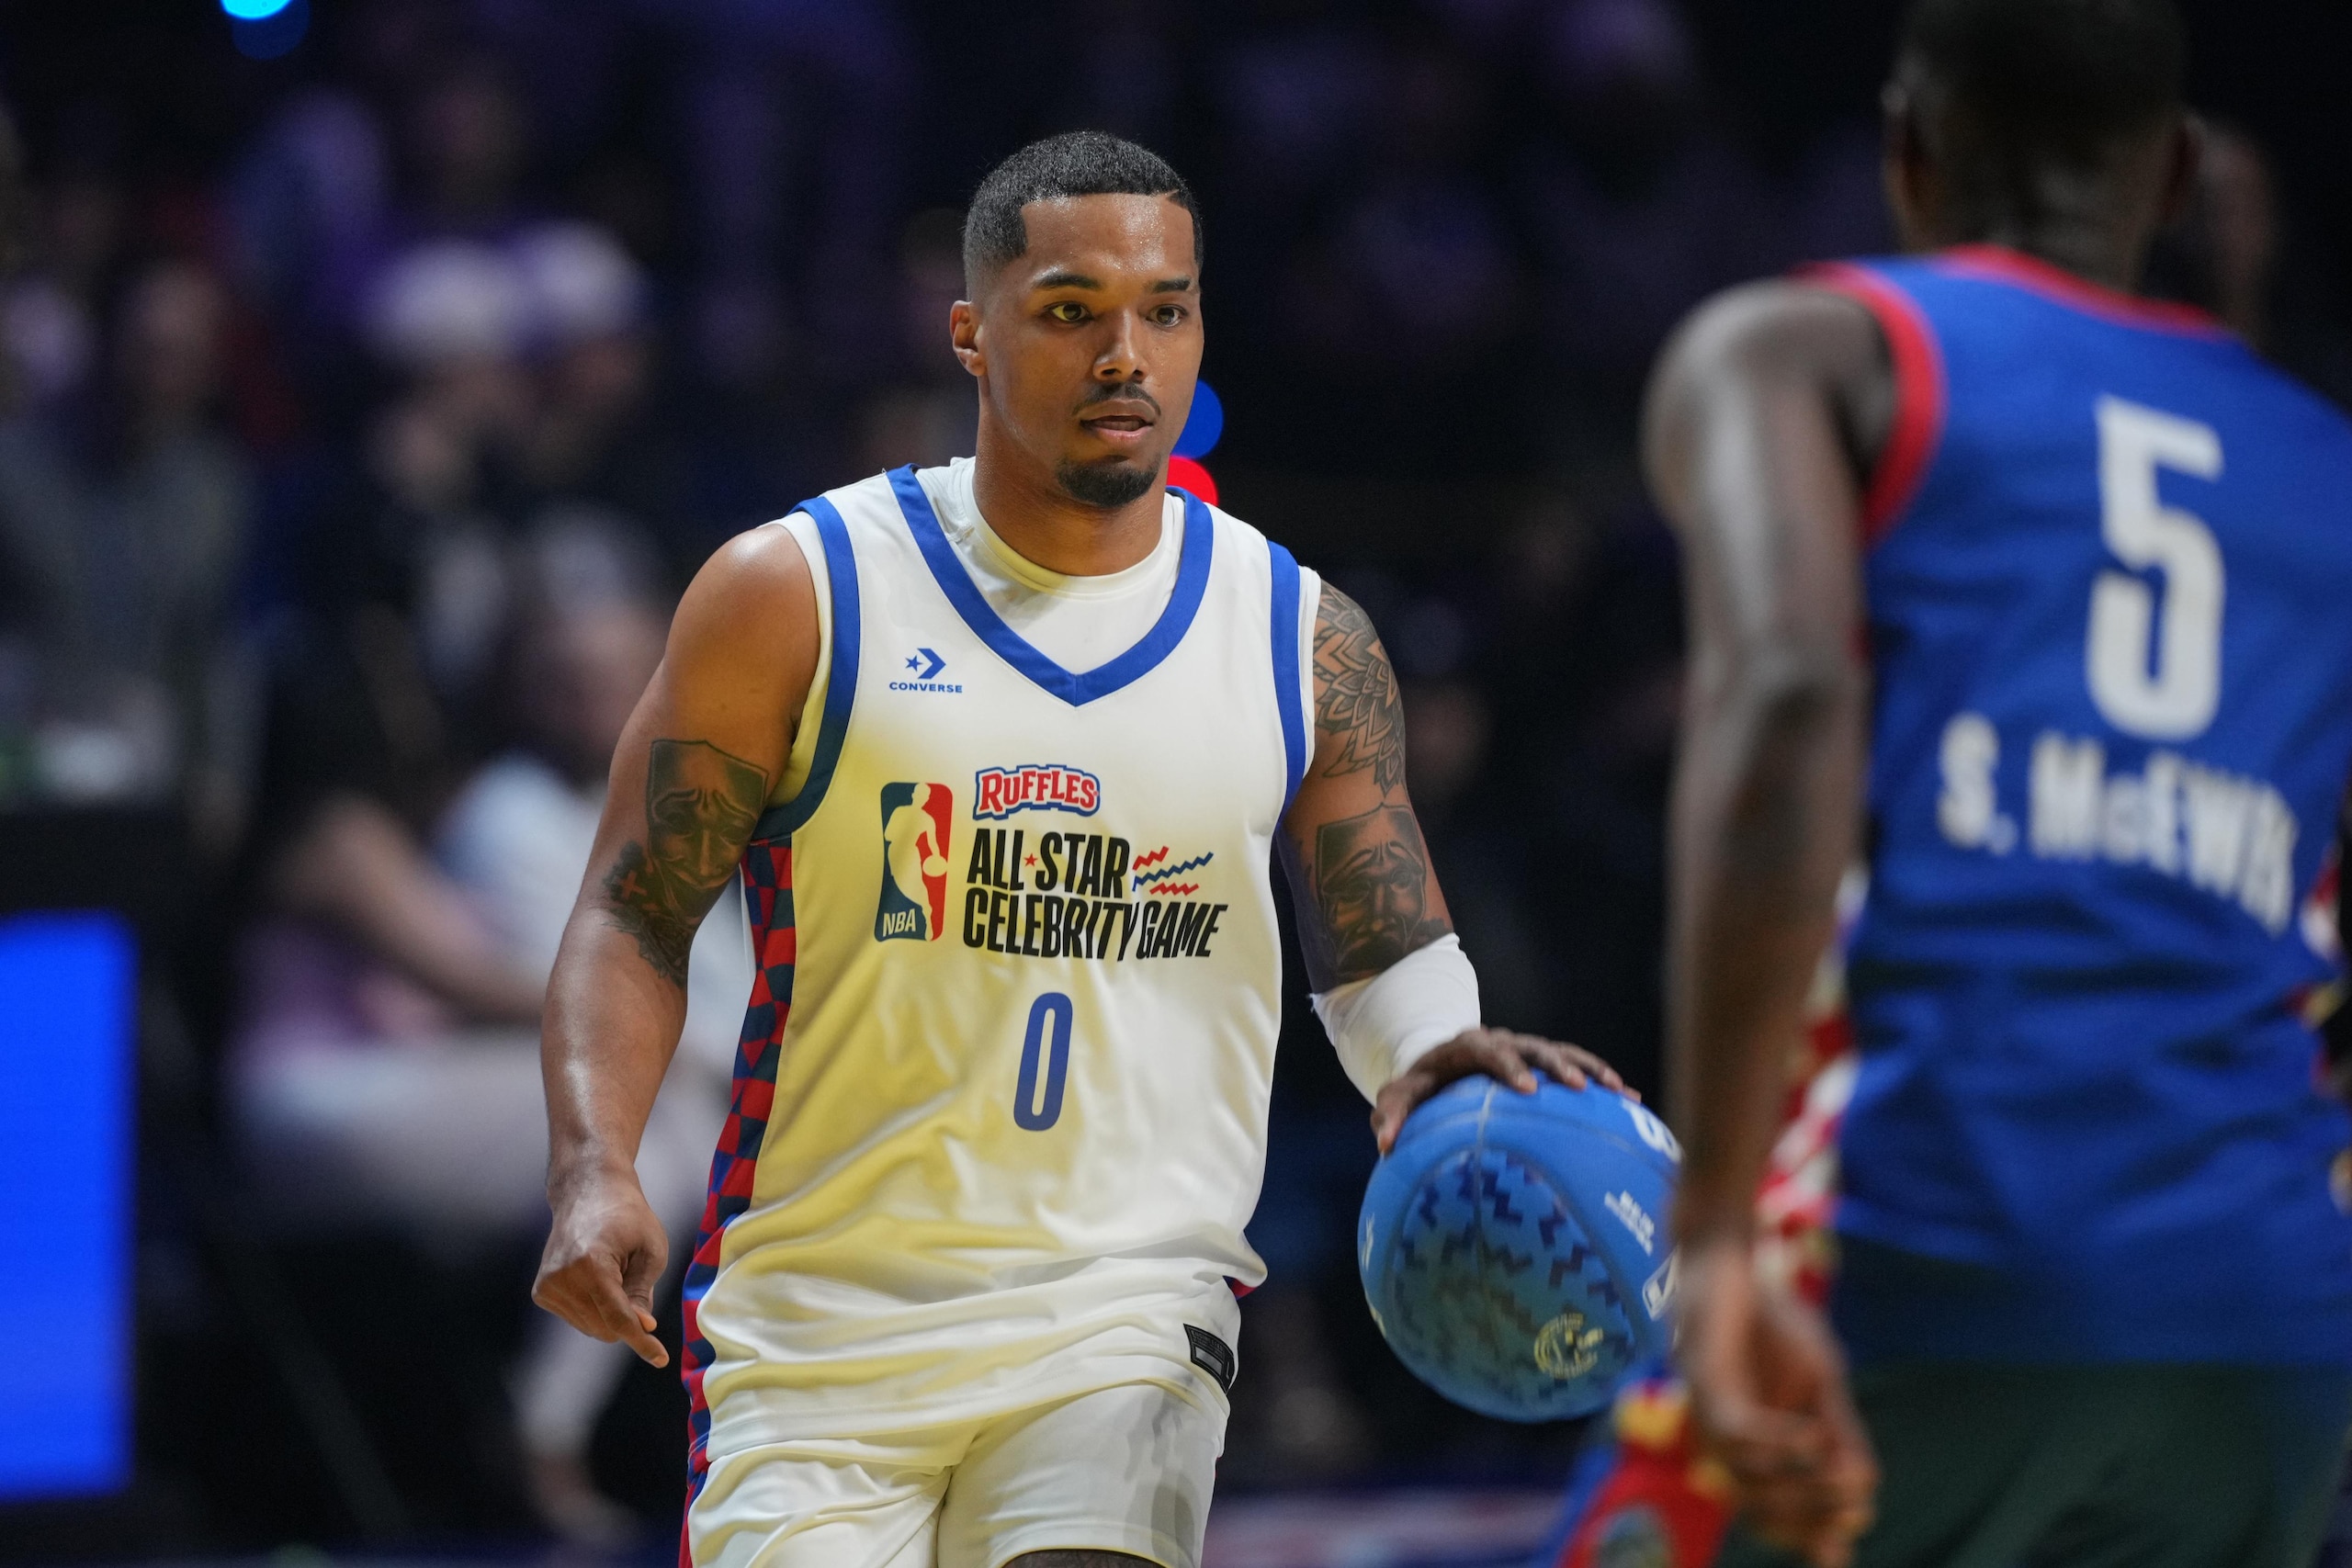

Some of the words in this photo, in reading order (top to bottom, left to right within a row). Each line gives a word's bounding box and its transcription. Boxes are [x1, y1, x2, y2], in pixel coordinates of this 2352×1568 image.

[2086, 393, 2225, 739] 5
[889, 682, 963, 694] CONVERSE
[979, 770, 1095, 812] RUFFLES
[1035, 831, 1130, 898] STAR
[883, 908, 916, 937] NBA
[963, 887, 1139, 962] CELEBRITY
[1136, 901, 1228, 959] GAME
[1013, 992, 1073, 1132] 0
